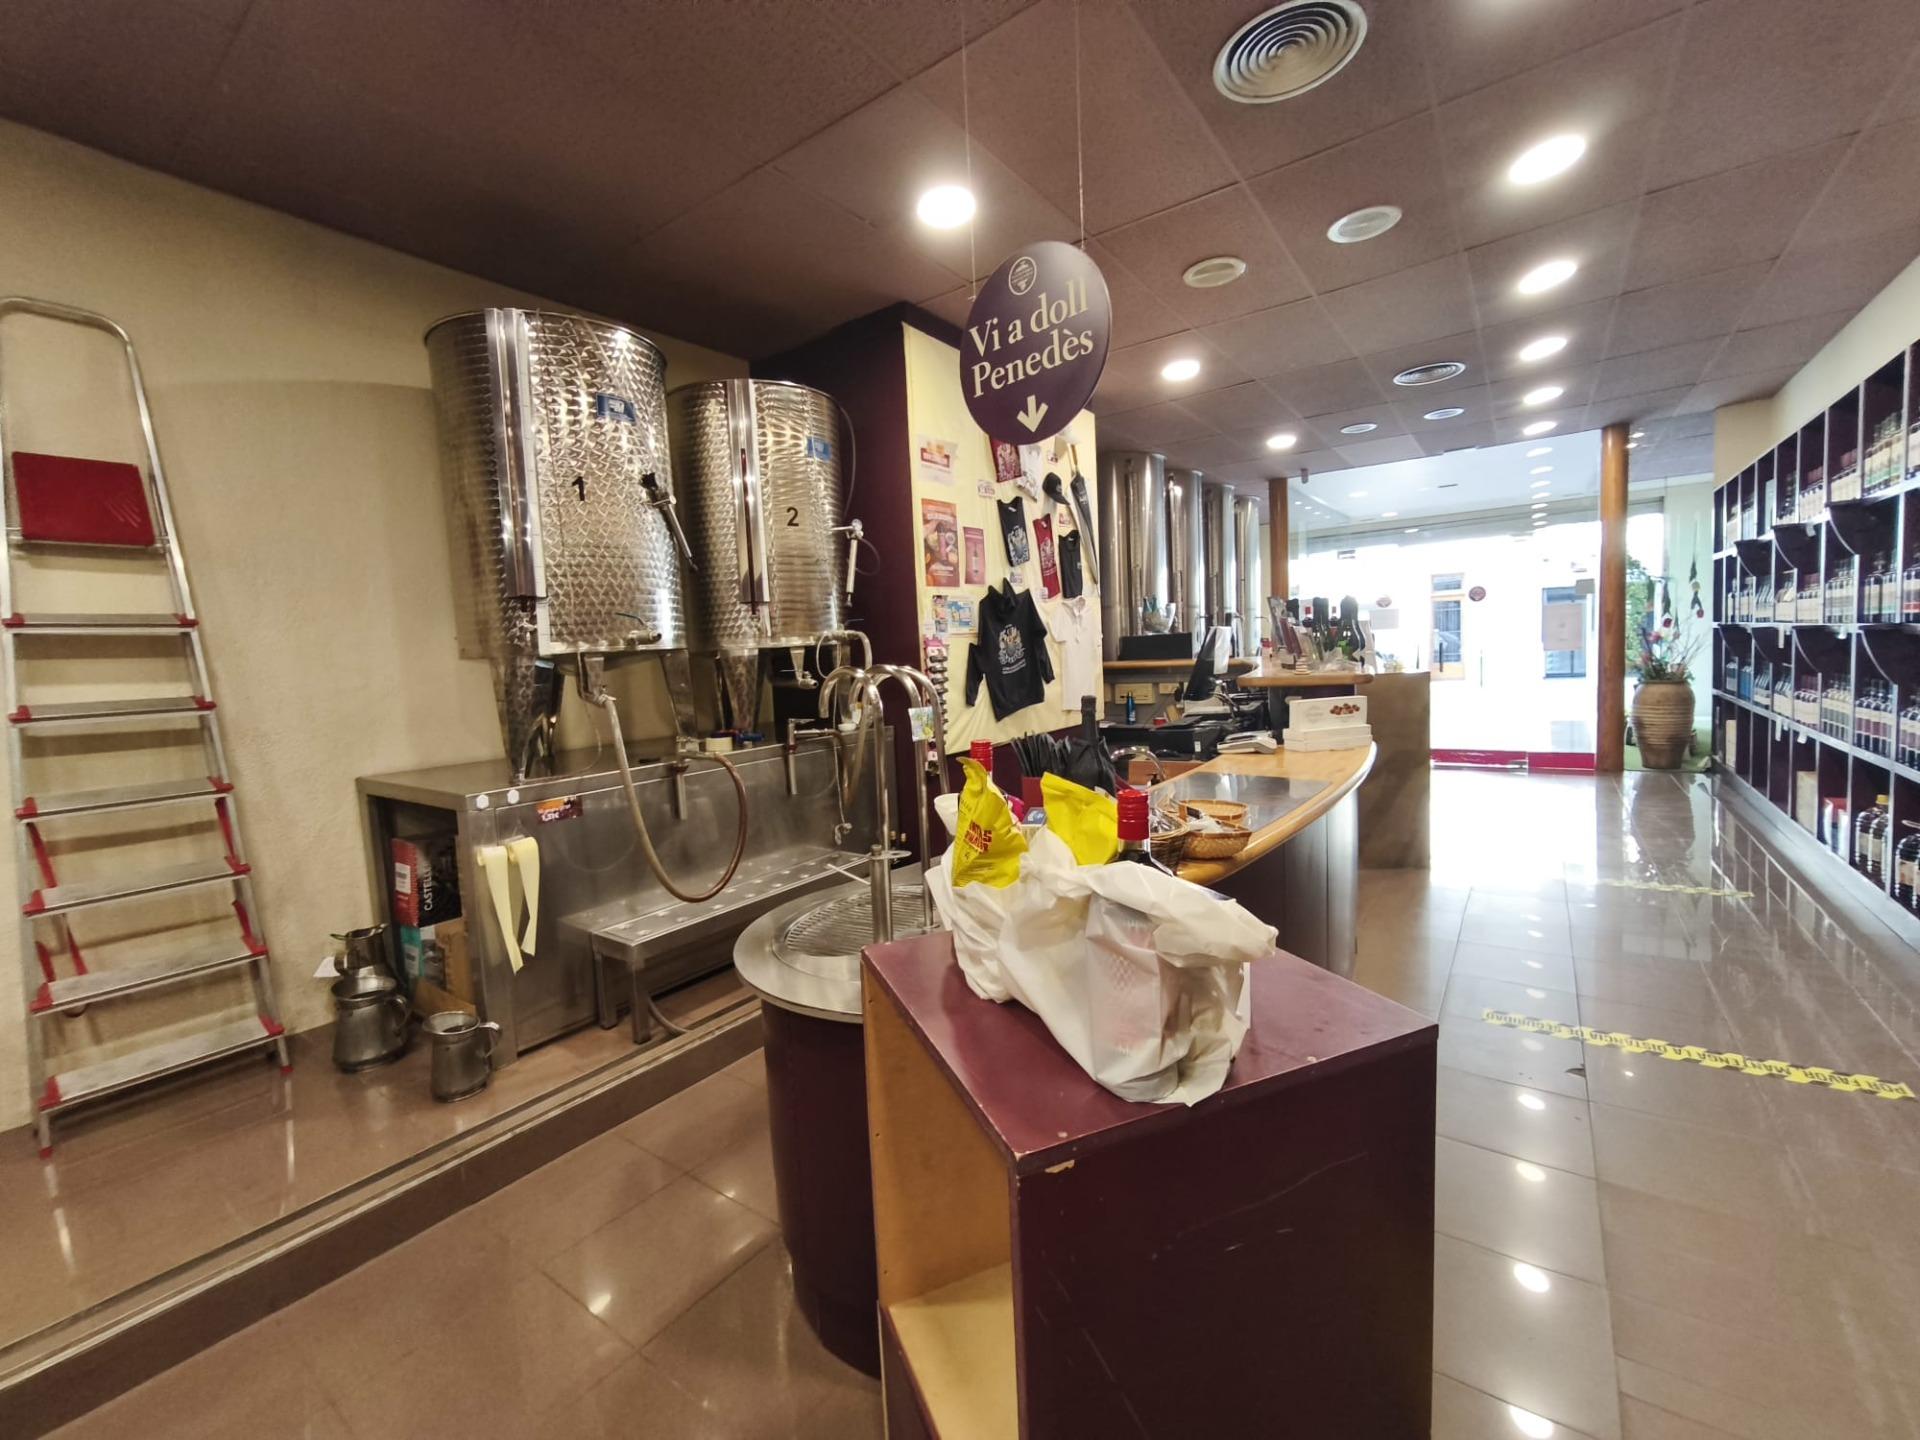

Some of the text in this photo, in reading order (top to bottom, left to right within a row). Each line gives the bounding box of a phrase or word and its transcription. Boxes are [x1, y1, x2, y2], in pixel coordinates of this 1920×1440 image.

[969, 317, 1001, 357] Vi
[1008, 319, 1024, 345] a
[1030, 276, 1089, 333] doll
[971, 329, 1094, 399] Penedès
[572, 475, 585, 501] 1
[786, 506, 799, 526] 2
